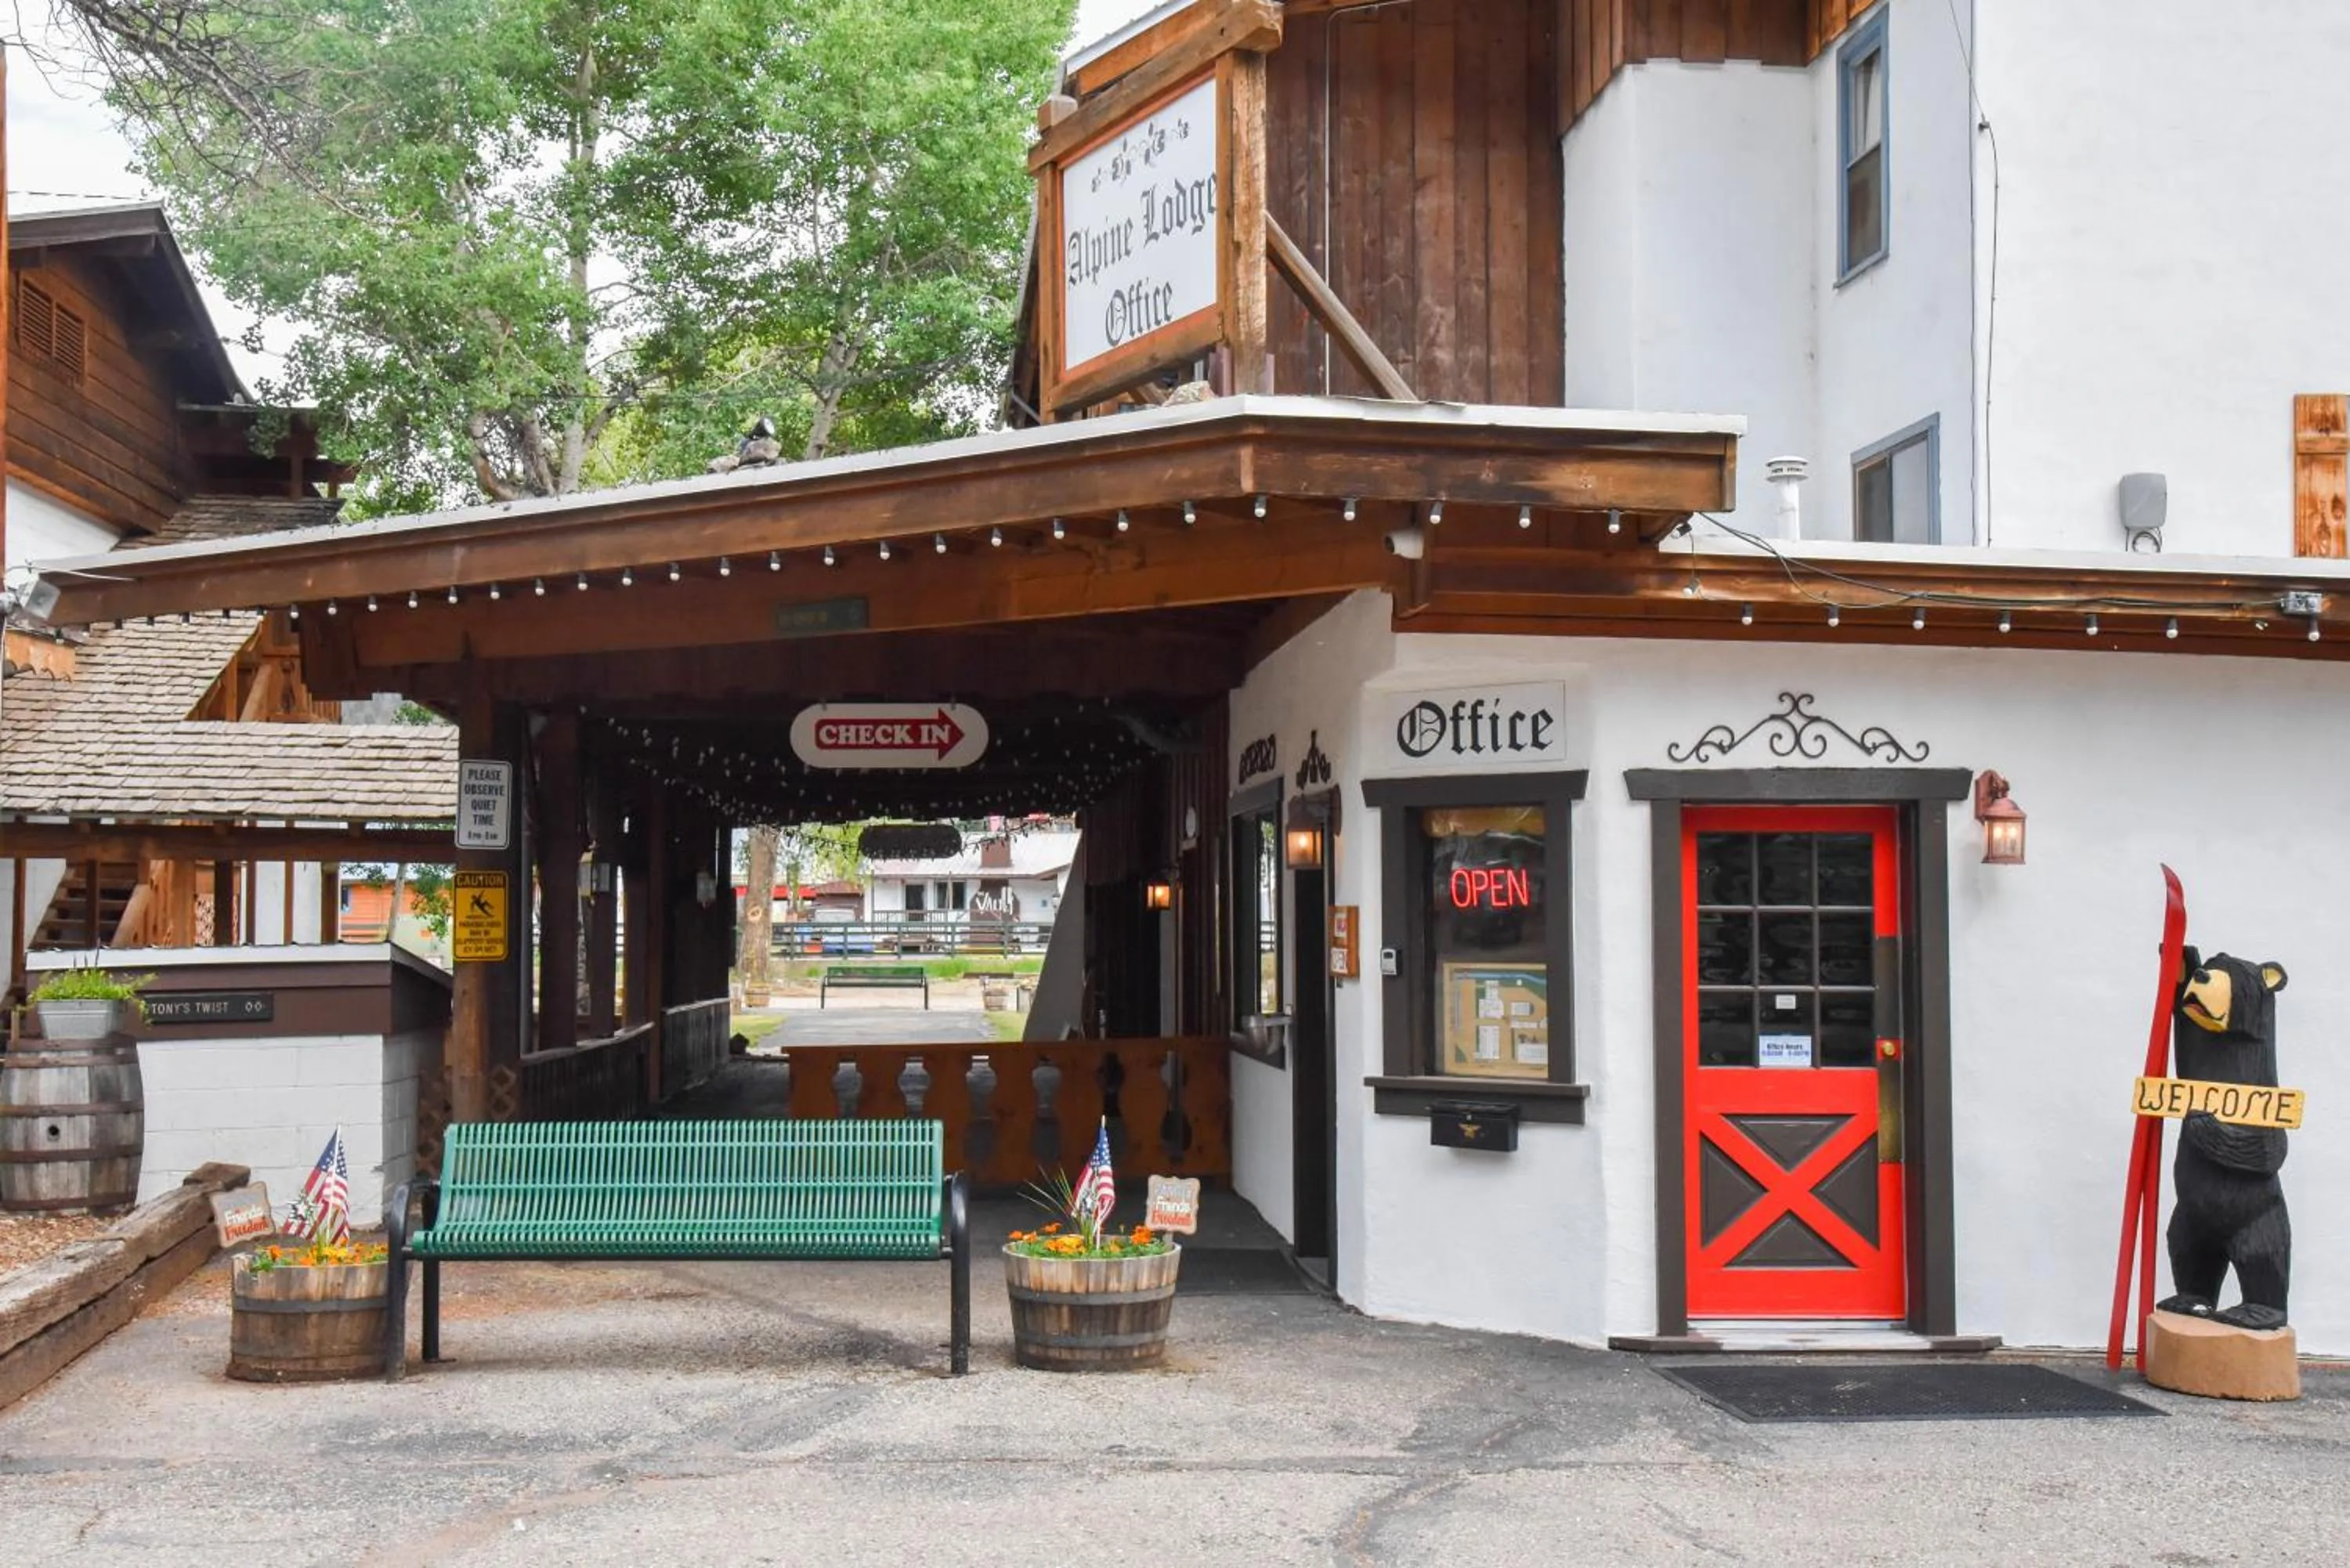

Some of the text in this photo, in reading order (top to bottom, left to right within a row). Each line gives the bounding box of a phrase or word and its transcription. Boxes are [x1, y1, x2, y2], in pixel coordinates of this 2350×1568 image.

[1068, 172, 1217, 287] Alpine Lodge
[1105, 277, 1173, 346] Office
[819, 724, 952, 745] CHECK IN
[1397, 696, 1554, 758] Office
[468, 768, 502, 781] PLEASE
[464, 784, 505, 797] OBSERVE
[471, 799, 497, 811] QUIET
[472, 814, 495, 826] TIME
[457, 874, 504, 887] CAUTION
[1450, 868, 1531, 909] OPEN
[151, 1002, 229, 1015] TONY'S TWIST
[2138, 1082, 2297, 1124] WELCOME
